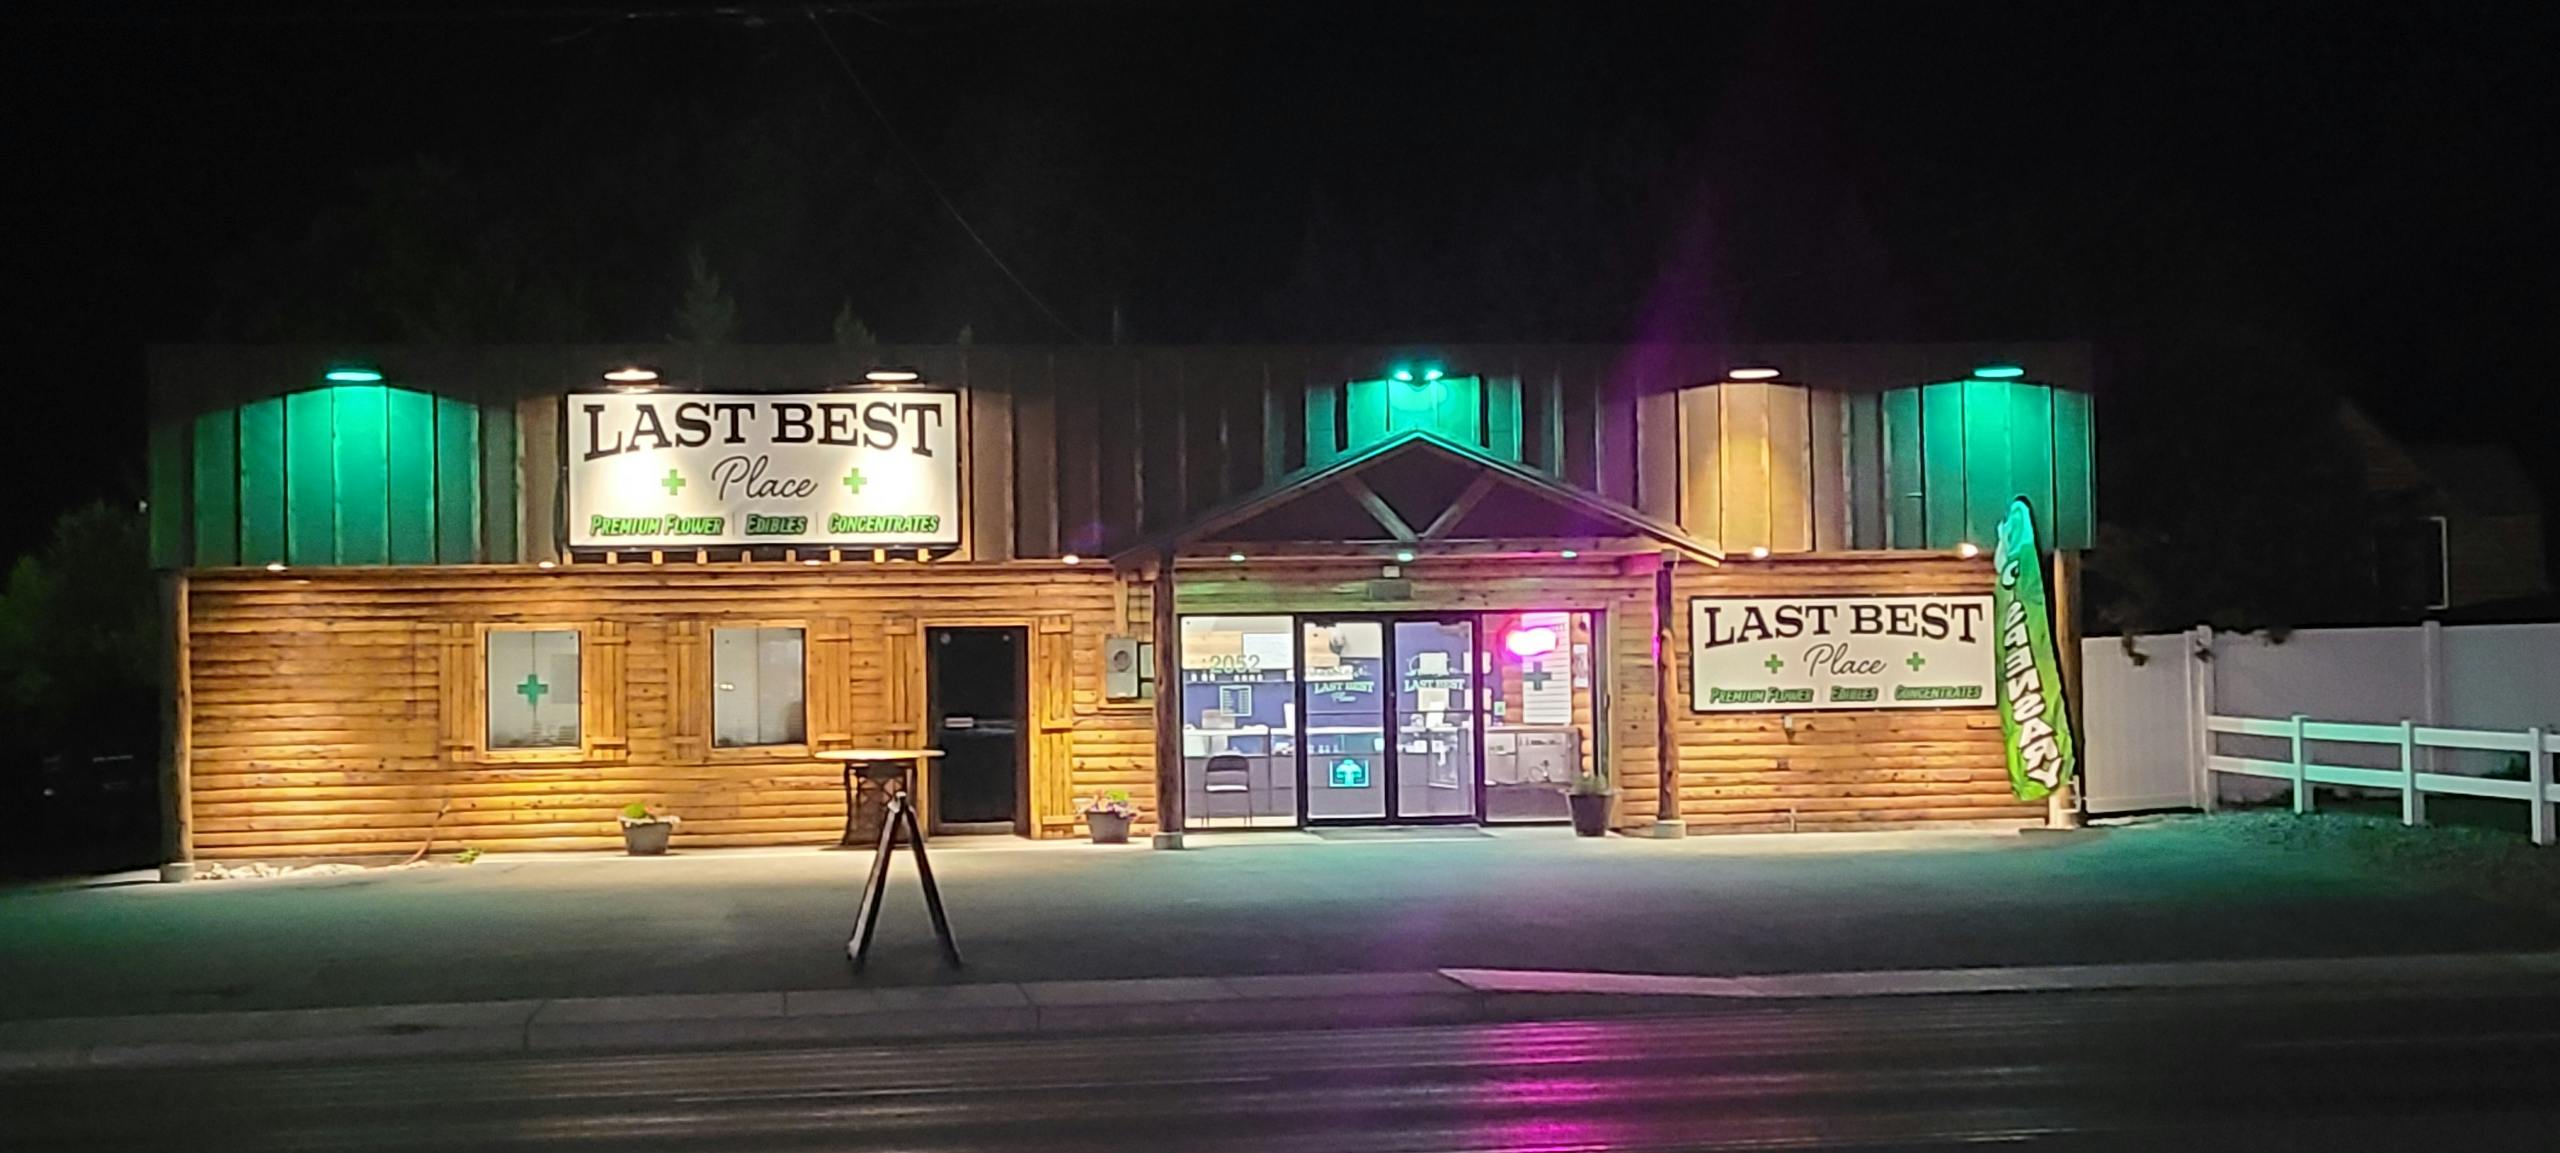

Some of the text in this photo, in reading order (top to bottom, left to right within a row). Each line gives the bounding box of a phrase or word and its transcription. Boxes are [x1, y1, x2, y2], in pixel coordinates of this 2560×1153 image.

[584, 401, 943, 462] LAST BEST
[711, 454, 818, 500] Place
[590, 514, 724, 536] PREMIUM FLOWER
[745, 514, 807, 535] EDIBLES
[827, 513, 939, 535] CONCENTRATES
[1704, 603, 1983, 649] LAST BEST
[1209, 654, 1261, 674] 2052
[1804, 643, 1887, 677] Place
